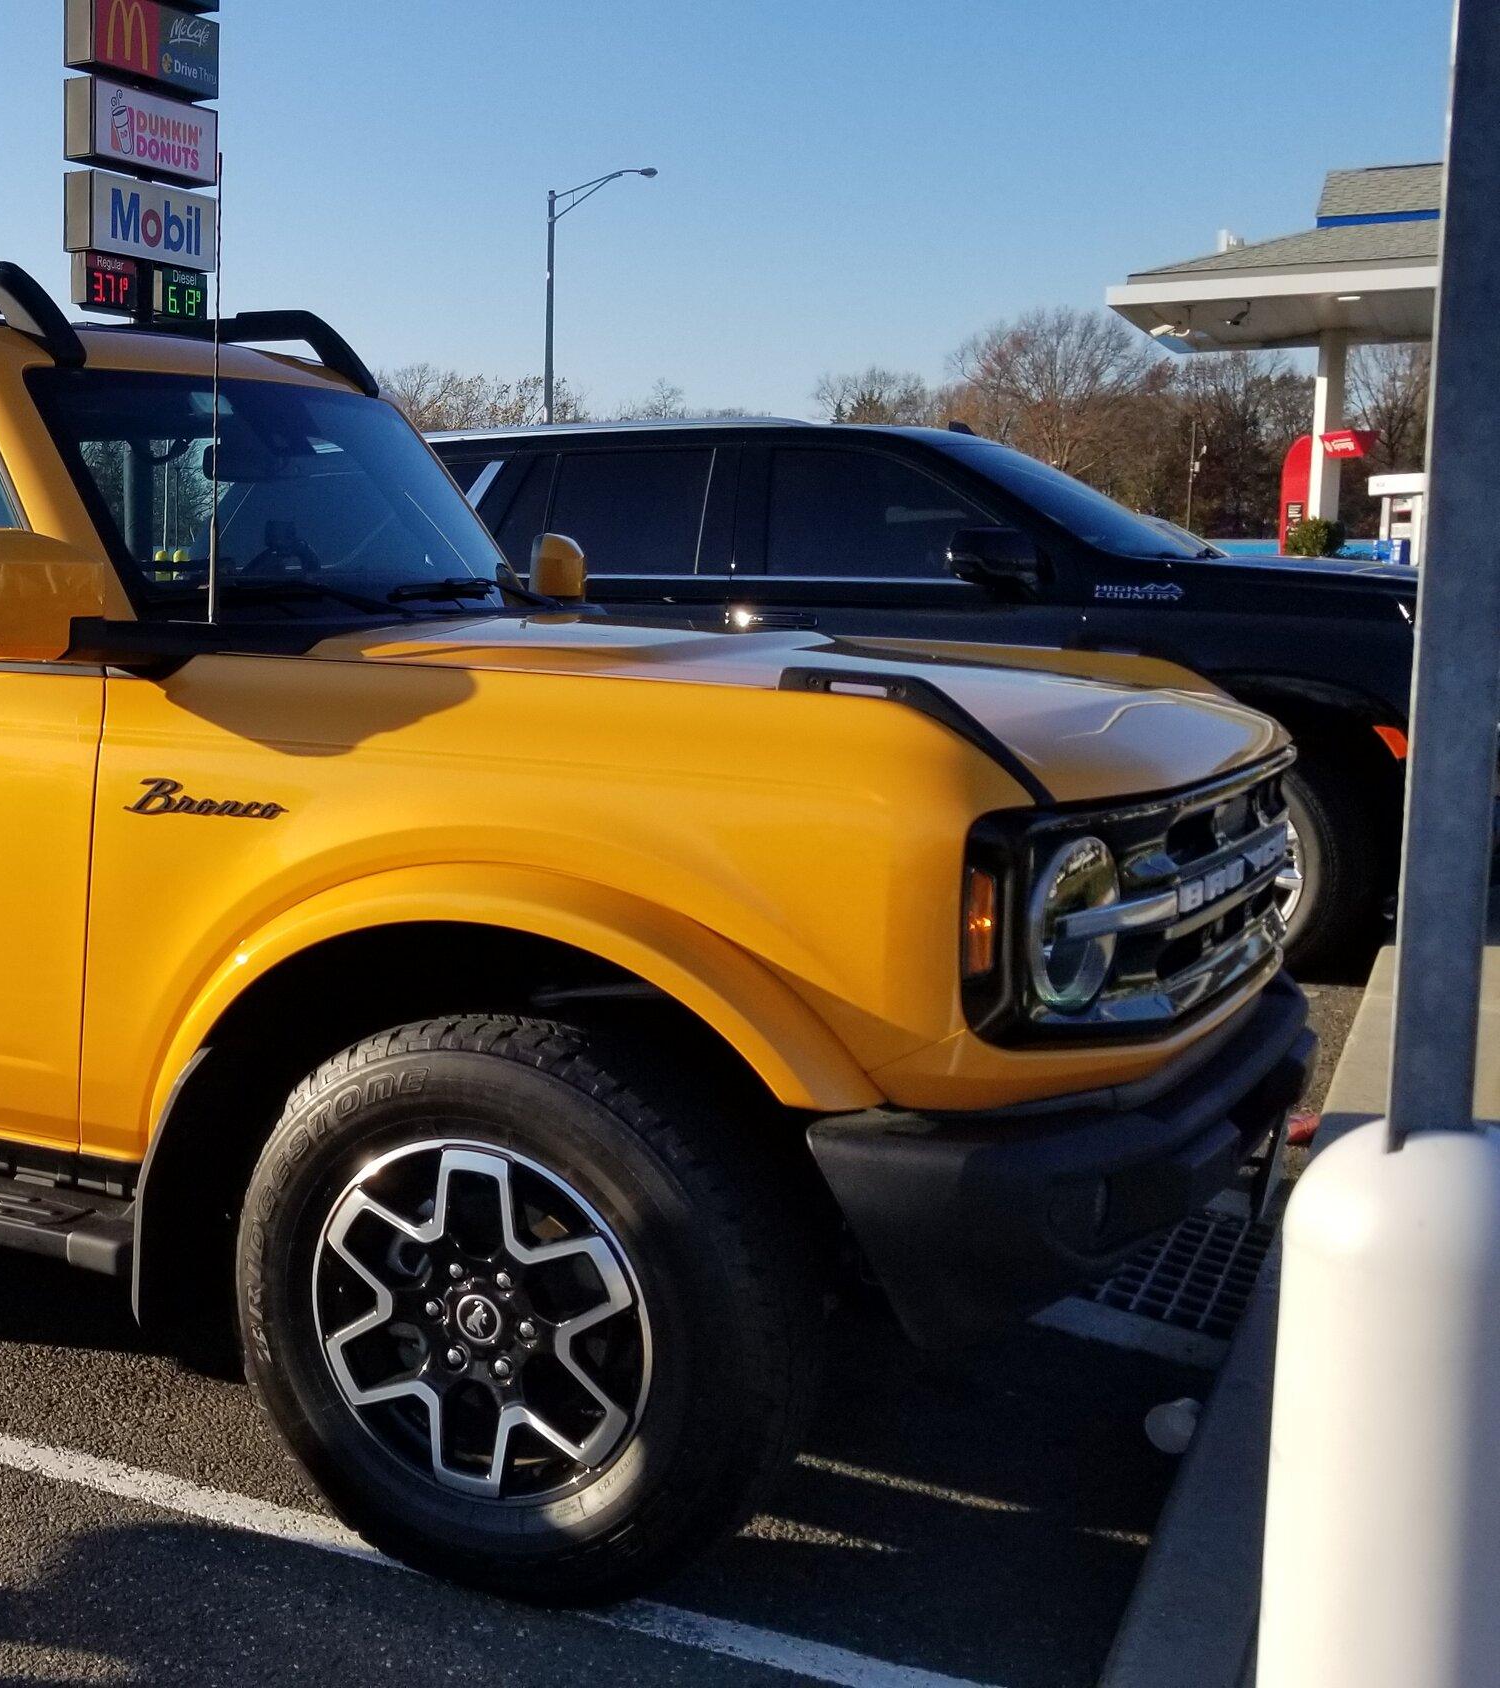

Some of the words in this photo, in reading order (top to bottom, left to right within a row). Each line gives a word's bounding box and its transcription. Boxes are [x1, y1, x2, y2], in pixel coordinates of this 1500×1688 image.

[174, 59, 198, 79] Drive
[137, 110, 202, 146] DUNKIN'
[137, 135, 199, 171] DONUTS
[111, 188, 200, 256] Mobil
[97, 256, 124, 271] Regular
[173, 270, 197, 286] Diesel
[1094, 592, 1178, 600] COUNTRY
[1095, 584, 1140, 592] HIGH
[123, 777, 289, 820] Bronco
[245, 1066, 430, 1363] BRIDGESTONE
